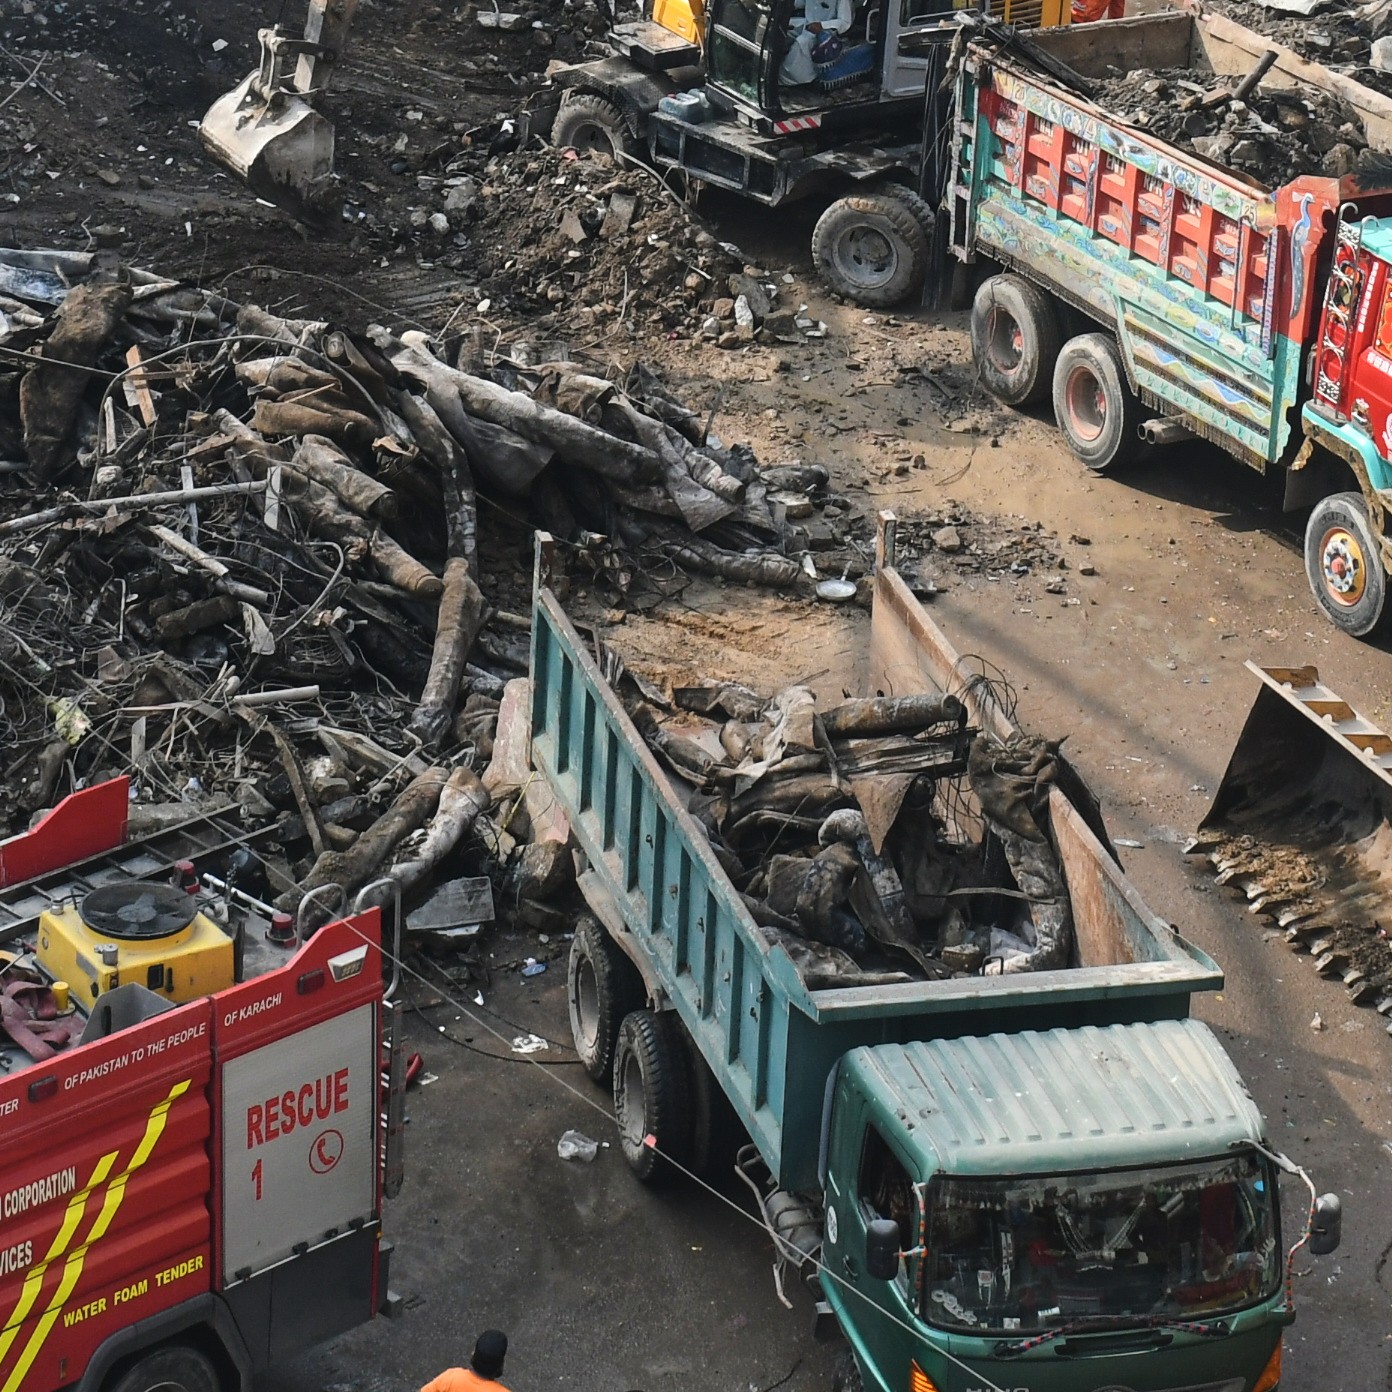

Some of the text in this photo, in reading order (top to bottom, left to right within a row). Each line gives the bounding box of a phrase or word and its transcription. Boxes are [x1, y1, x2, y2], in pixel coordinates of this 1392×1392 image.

[64, 1074, 79, 1090] OF
[79, 1054, 129, 1085] PAKISTAN
[131, 1047, 144, 1064] TO
[146, 1038, 165, 1058] THE
[167, 1022, 207, 1049] PEOPLE
[224, 1012, 239, 1027] OF
[239, 992, 282, 1021] KARACHI
[247, 1067, 349, 1150] RESCUE
[4, 1166, 77, 1218] CORPORATION
[63, 1255, 204, 1328] WATER FOAM TENDER
